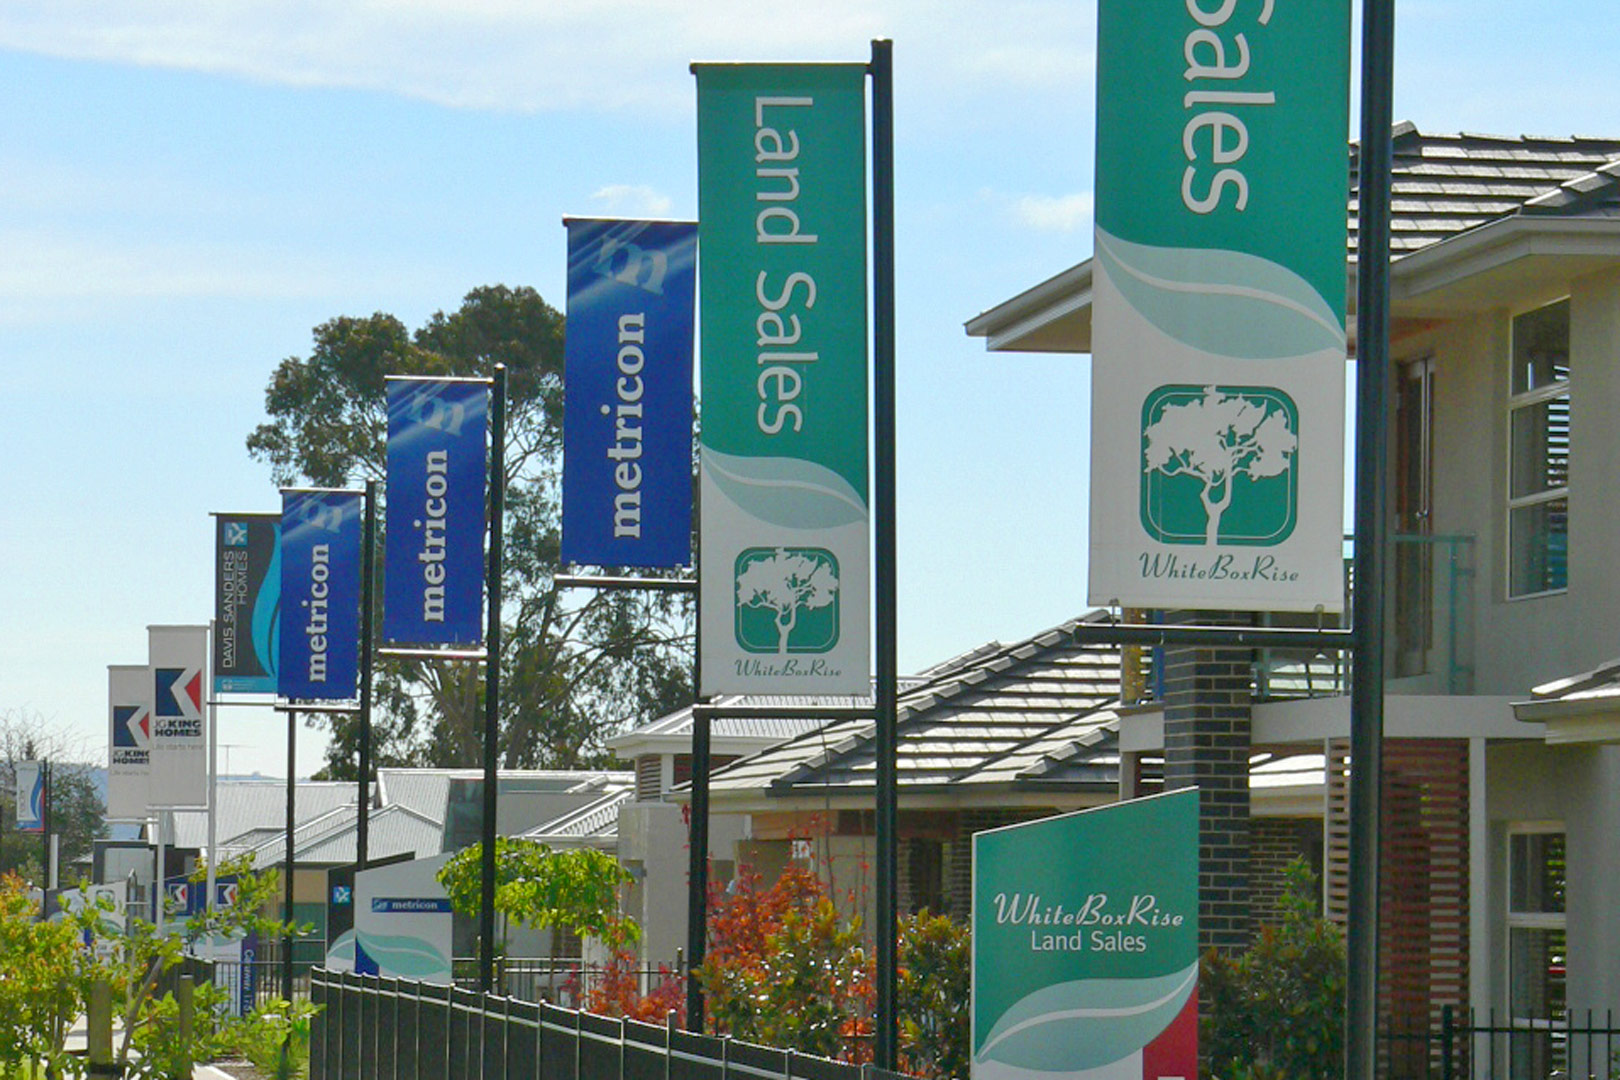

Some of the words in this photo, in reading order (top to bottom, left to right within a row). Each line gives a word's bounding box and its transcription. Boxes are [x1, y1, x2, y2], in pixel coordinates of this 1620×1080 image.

[755, 96, 819, 244] Land
[755, 270, 819, 435] Sales
[601, 312, 645, 539] metricon
[413, 449, 448, 622] metricon
[223, 551, 235, 623] SANDERS
[236, 551, 249, 606] HOMES
[302, 543, 330, 683] metricon
[222, 627, 234, 668] DAVIS
[155, 729, 202, 737] HOMES
[392, 900, 438, 910] metricon
[1031, 930, 1082, 951] Land
[1090, 930, 1147, 952] Sales
